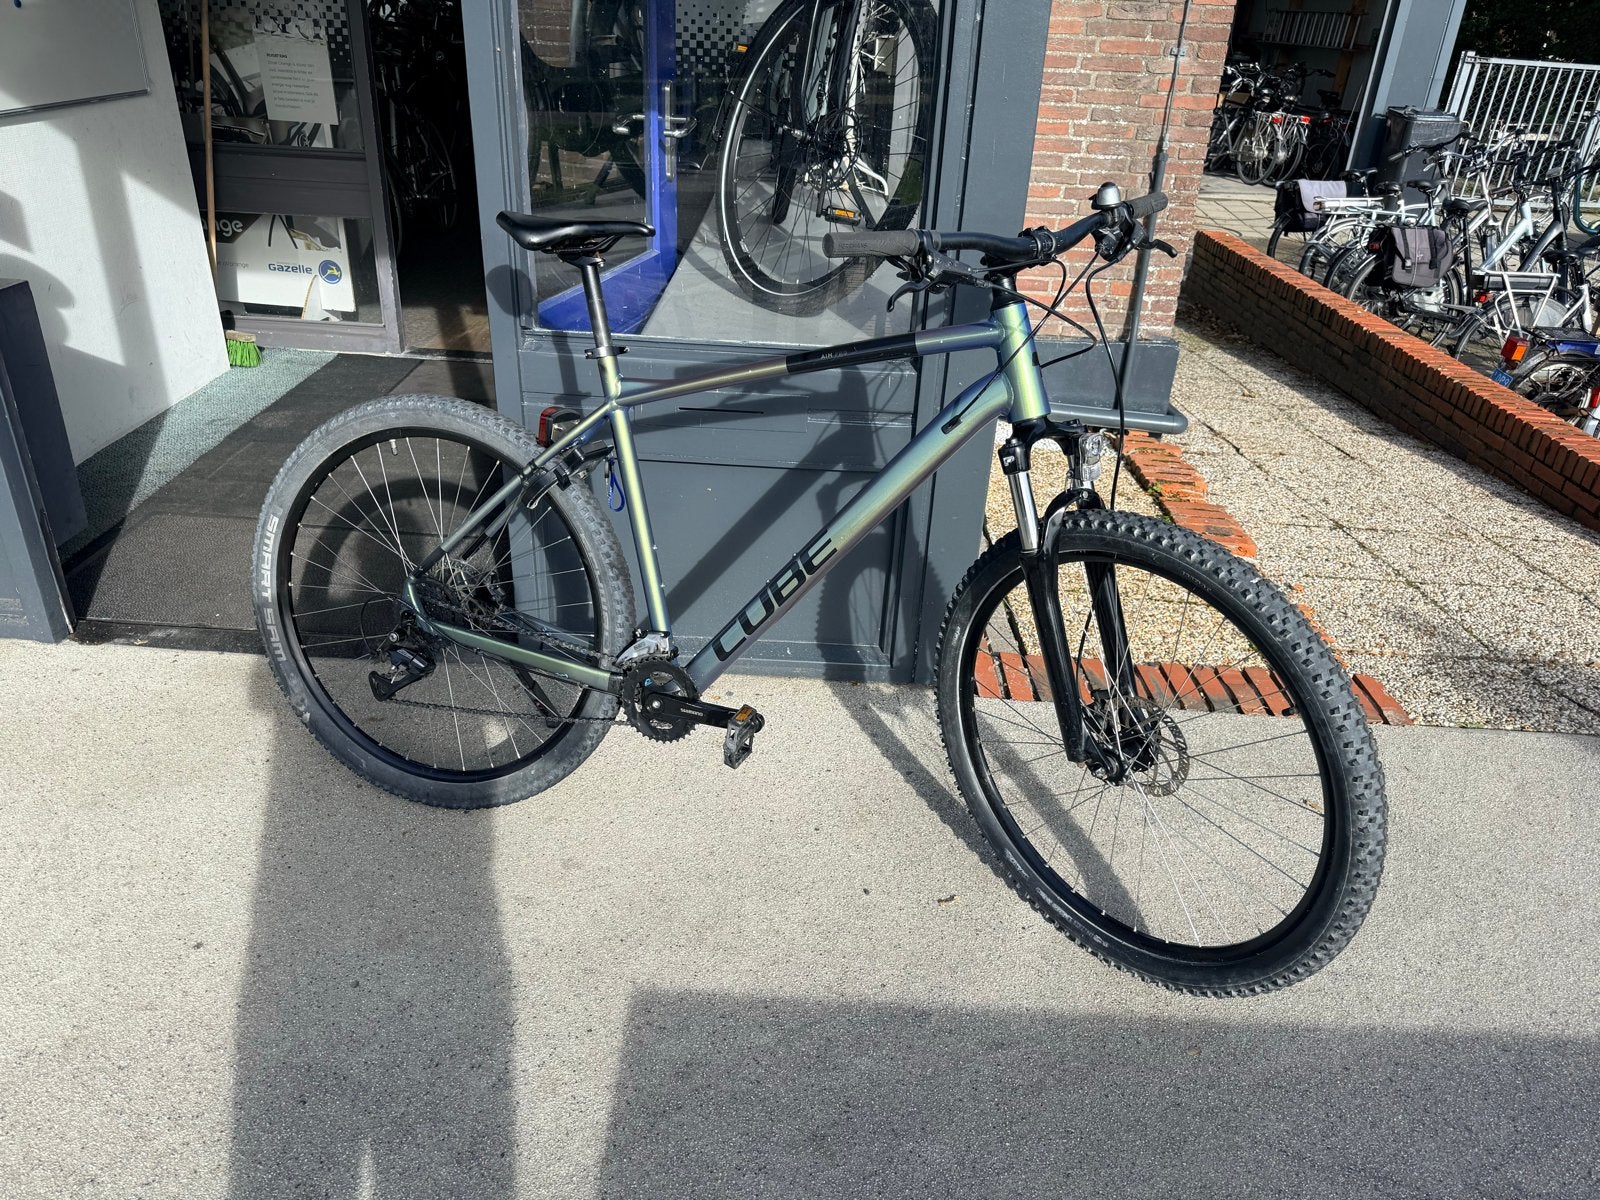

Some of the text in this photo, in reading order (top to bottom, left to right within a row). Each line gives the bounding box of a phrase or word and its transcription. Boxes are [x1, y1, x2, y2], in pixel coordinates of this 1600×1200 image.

[268, 263, 313, 275] Gazelle
[260, 514, 287, 662] SMART SAM
[711, 529, 838, 662] CUBE
